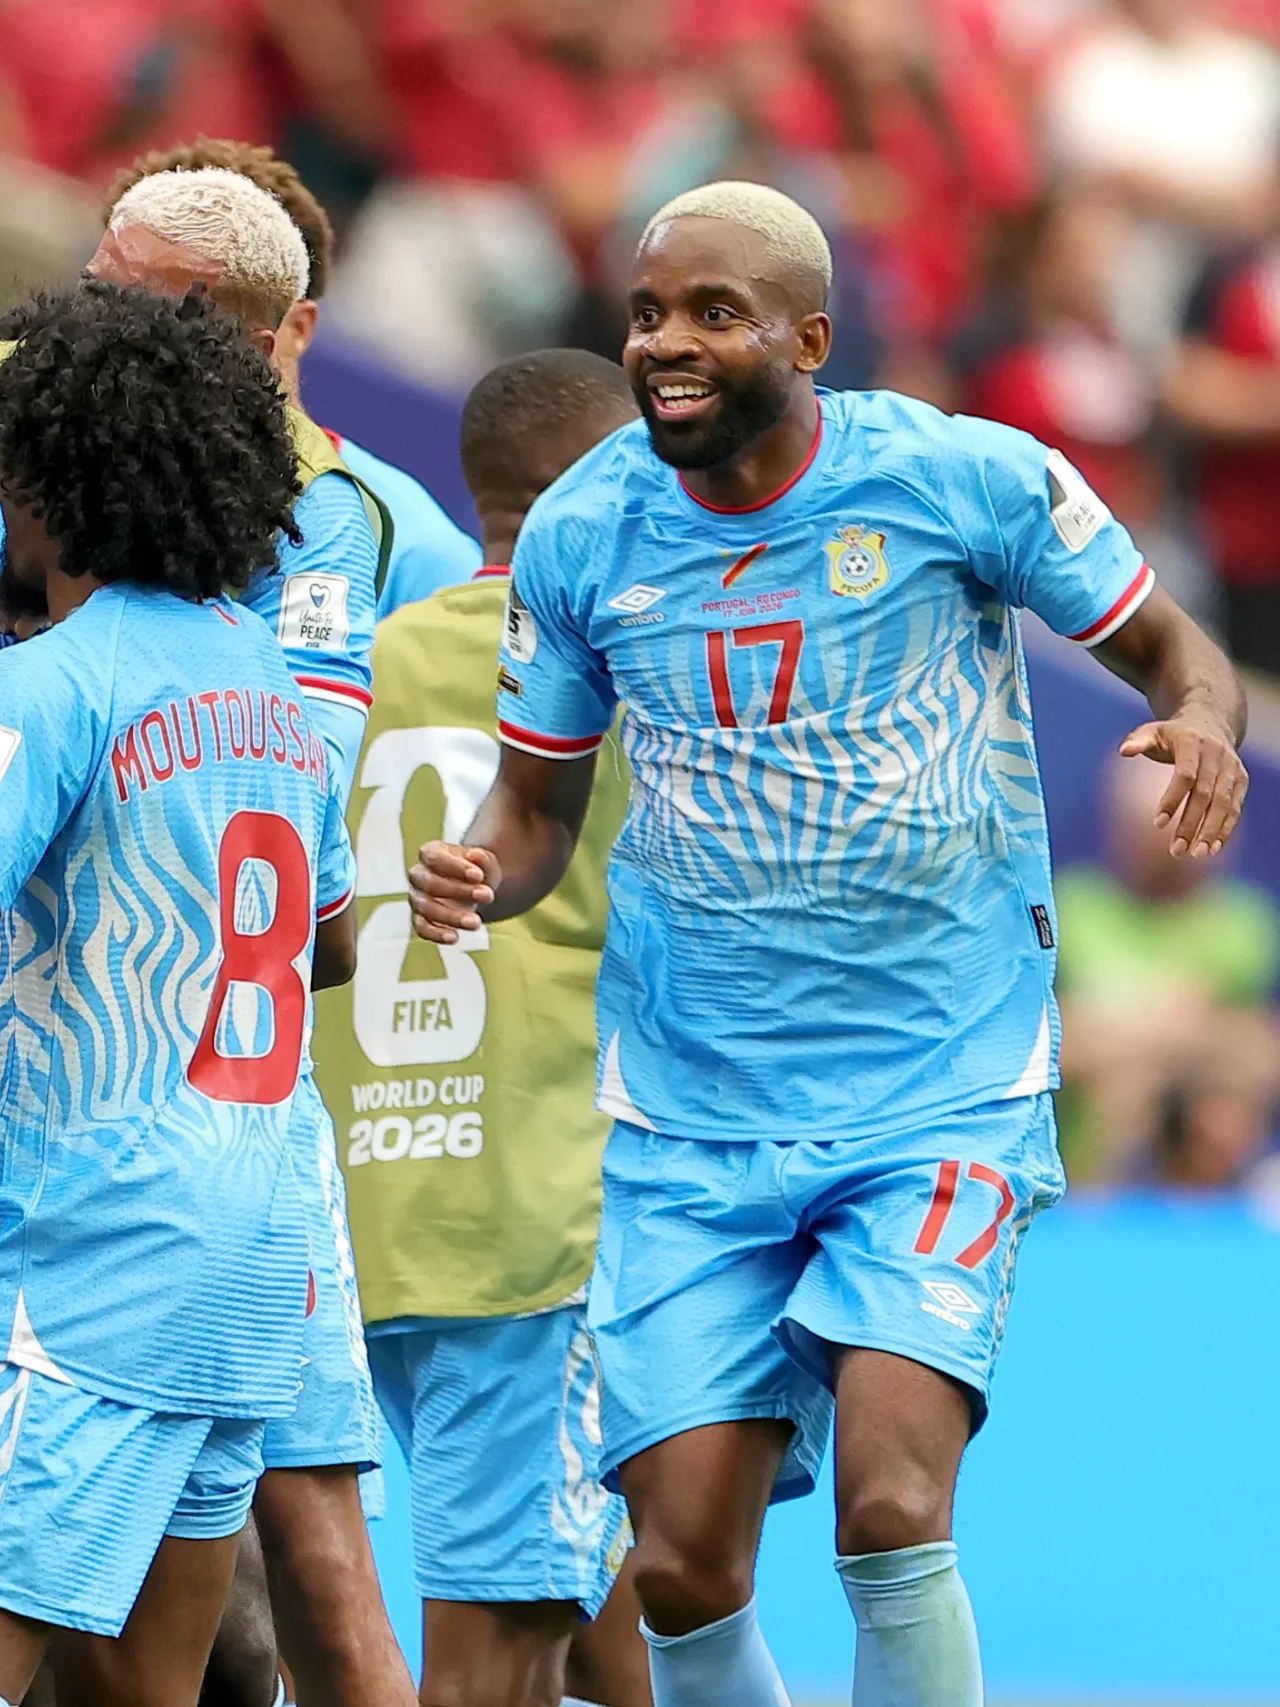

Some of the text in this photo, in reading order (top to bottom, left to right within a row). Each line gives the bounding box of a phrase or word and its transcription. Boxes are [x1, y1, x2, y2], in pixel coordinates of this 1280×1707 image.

[702, 599, 748, 612] PORTUGAL
[771, 588, 800, 601] CONGO
[841, 577, 881, 594] FECOFA
[618, 611, 666, 628] umbro
[760, 602, 783, 613] 2026
[300, 625, 332, 641] PEACE
[703, 618, 806, 729] 17
[186, 809, 313, 1107] 8
[392, 998, 454, 1034] FIFA
[350, 1074, 485, 1113] WORLD CUP
[347, 1111, 485, 1167] 2026
[913, 1160, 1015, 1270] 17
